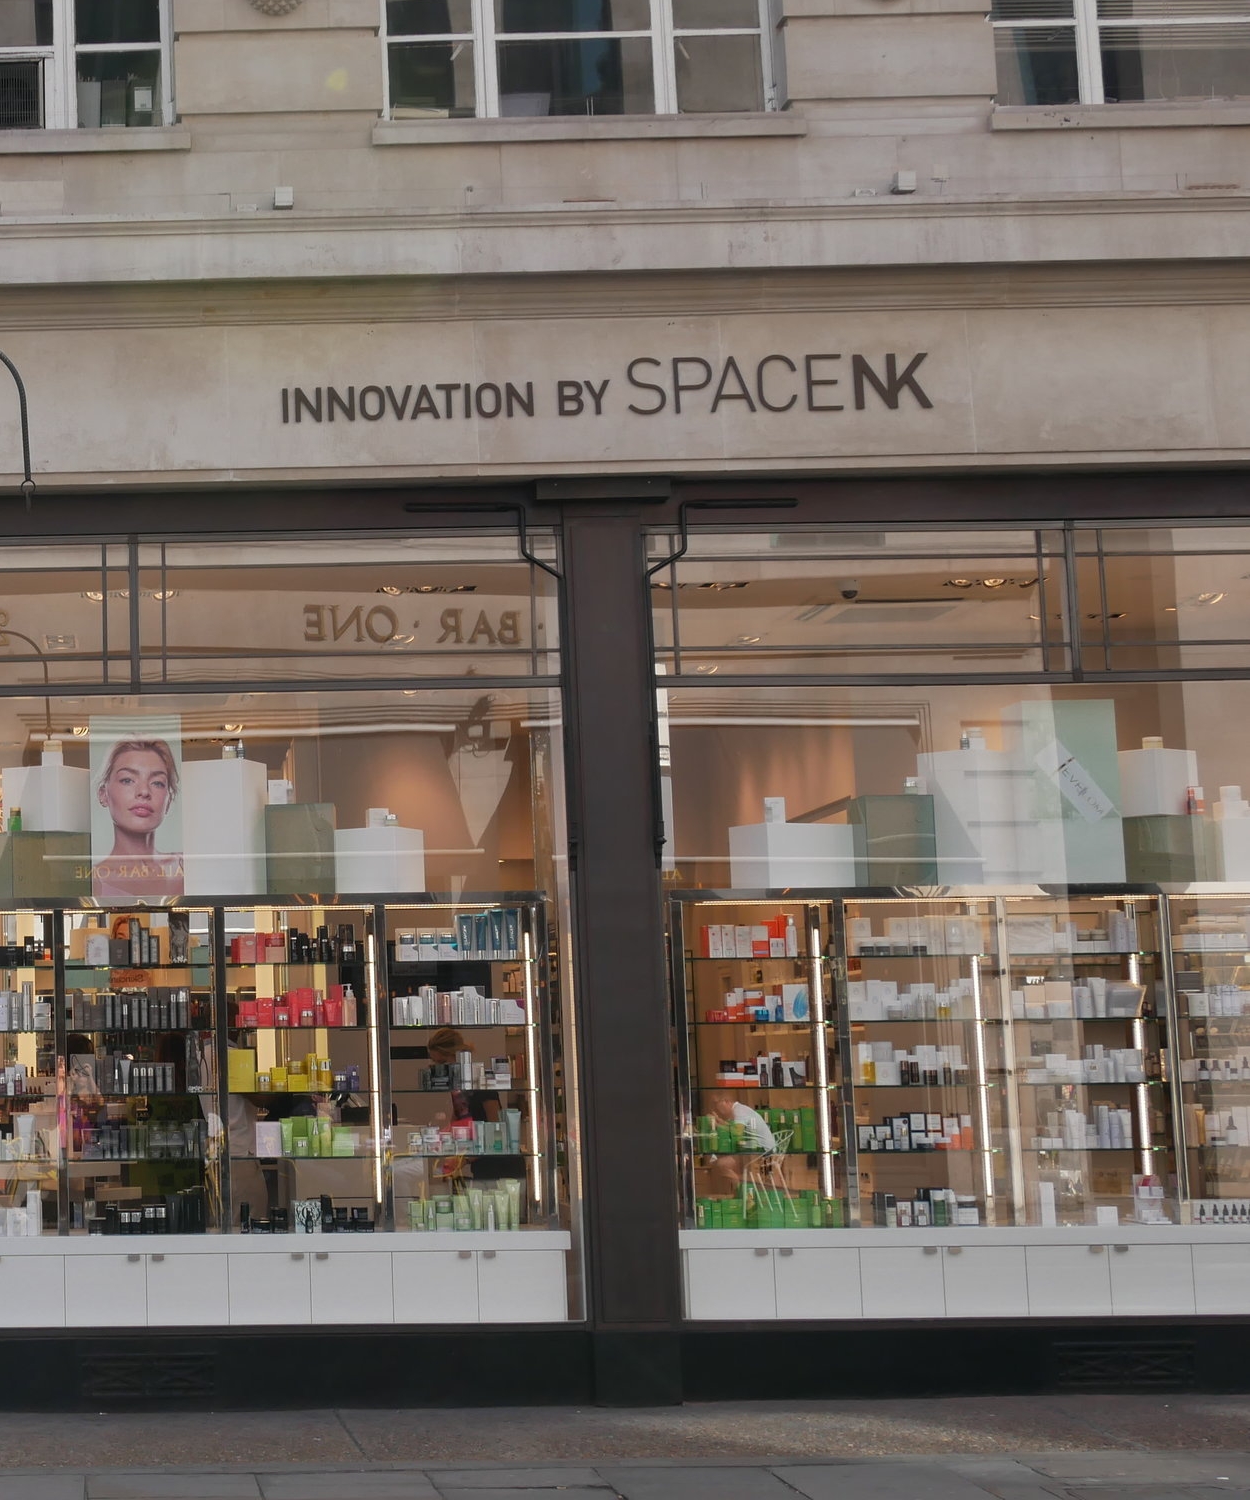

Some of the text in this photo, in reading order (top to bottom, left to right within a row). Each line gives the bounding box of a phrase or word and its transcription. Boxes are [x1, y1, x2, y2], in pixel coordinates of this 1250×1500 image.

[281, 352, 934, 424] INNOVATION BY SPACENK
